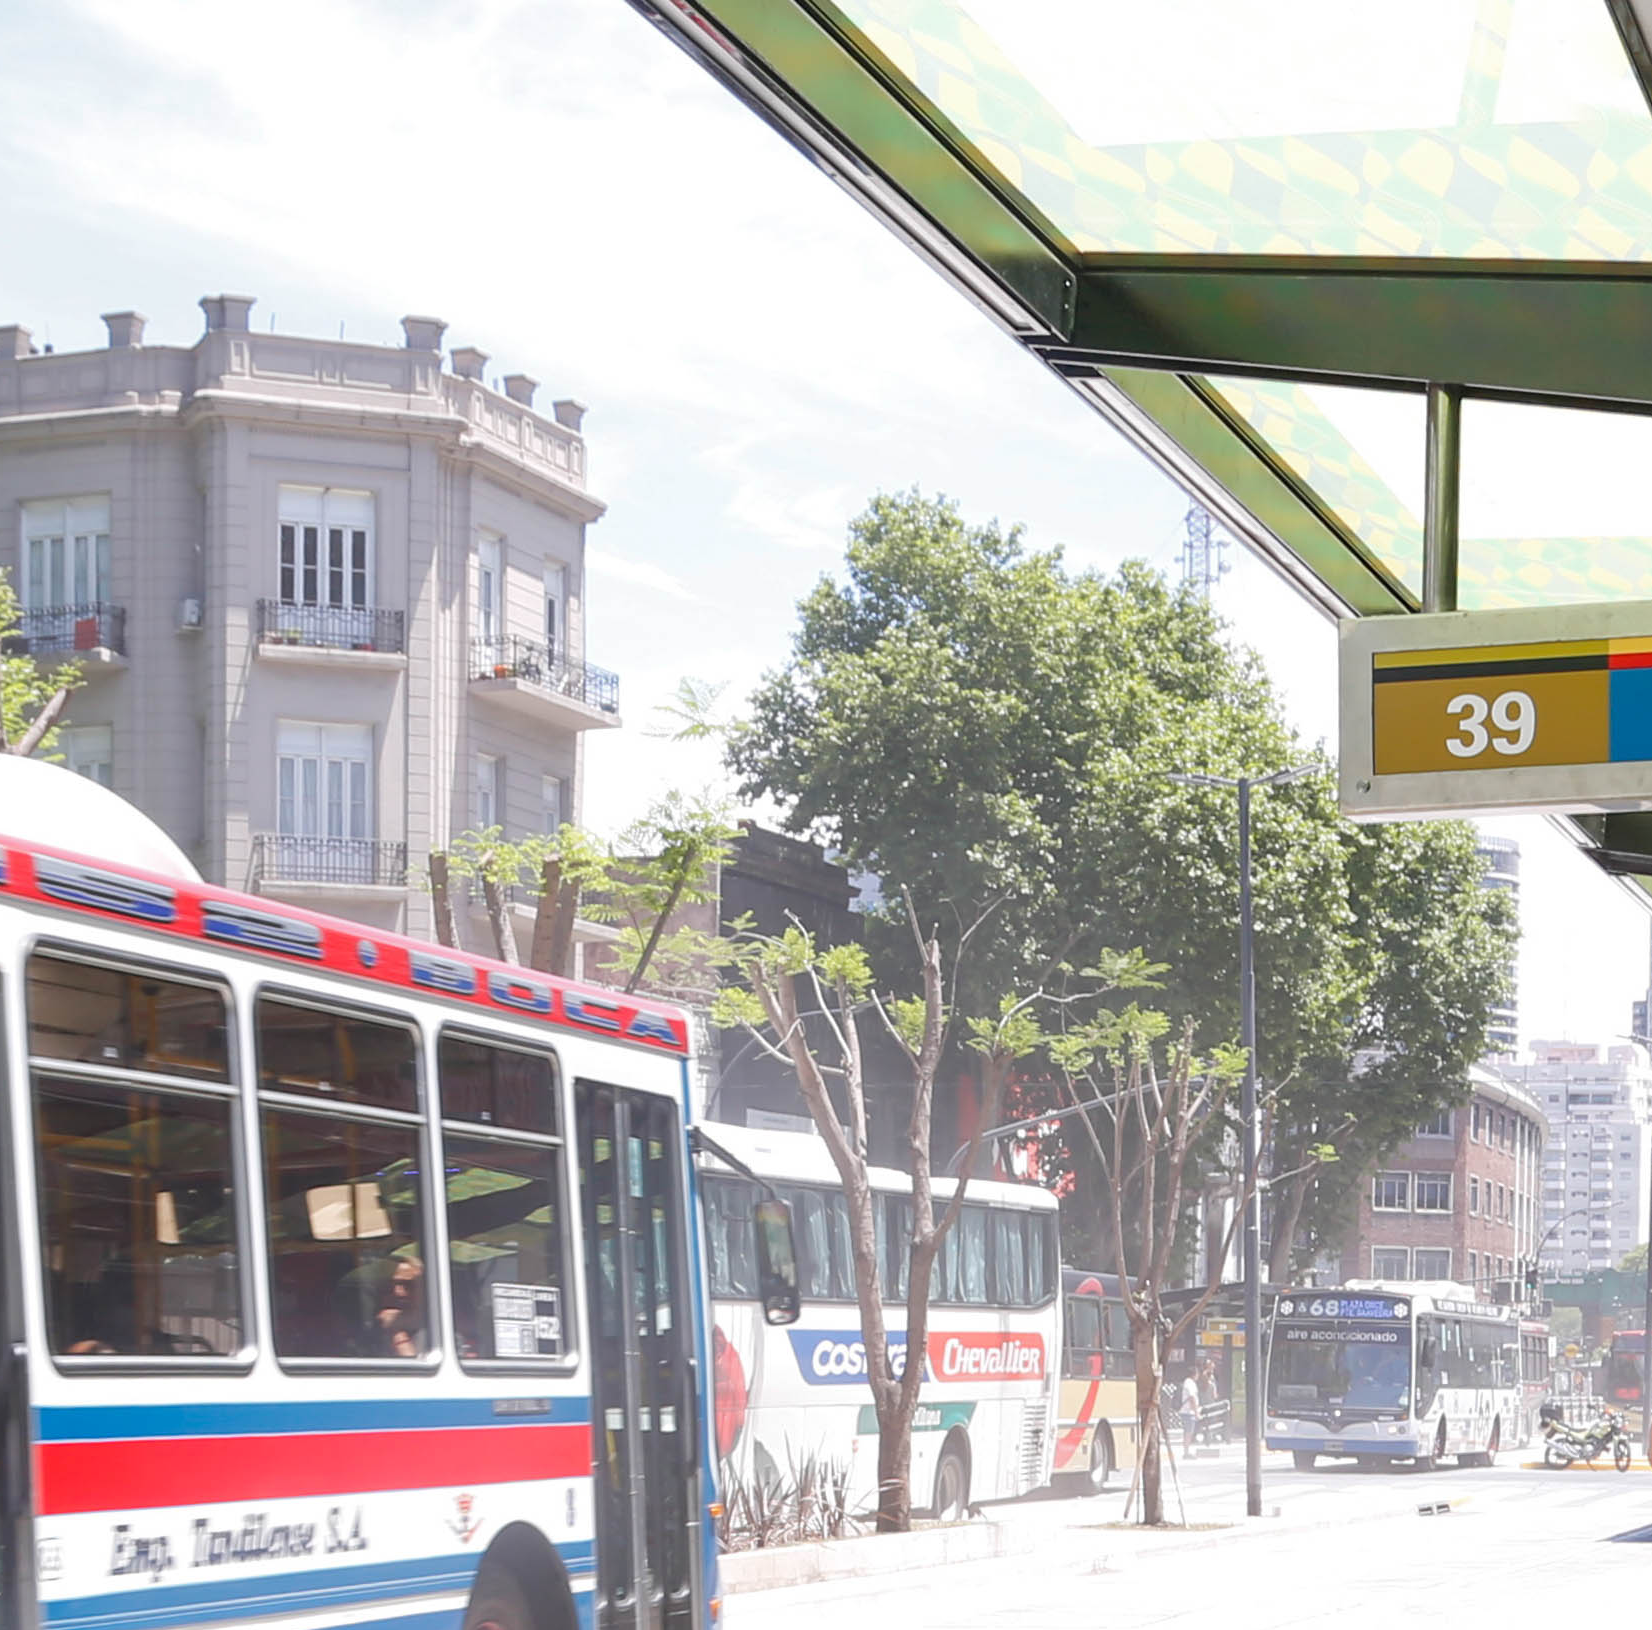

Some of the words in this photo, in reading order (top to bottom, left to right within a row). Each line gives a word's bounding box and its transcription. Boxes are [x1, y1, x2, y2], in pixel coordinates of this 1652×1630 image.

[1445, 691, 1537, 758] 39
[407, 949, 682, 1047] BOCA
[1309, 1299, 1340, 1317] 68
[1287, 1329, 1308, 1340] aire
